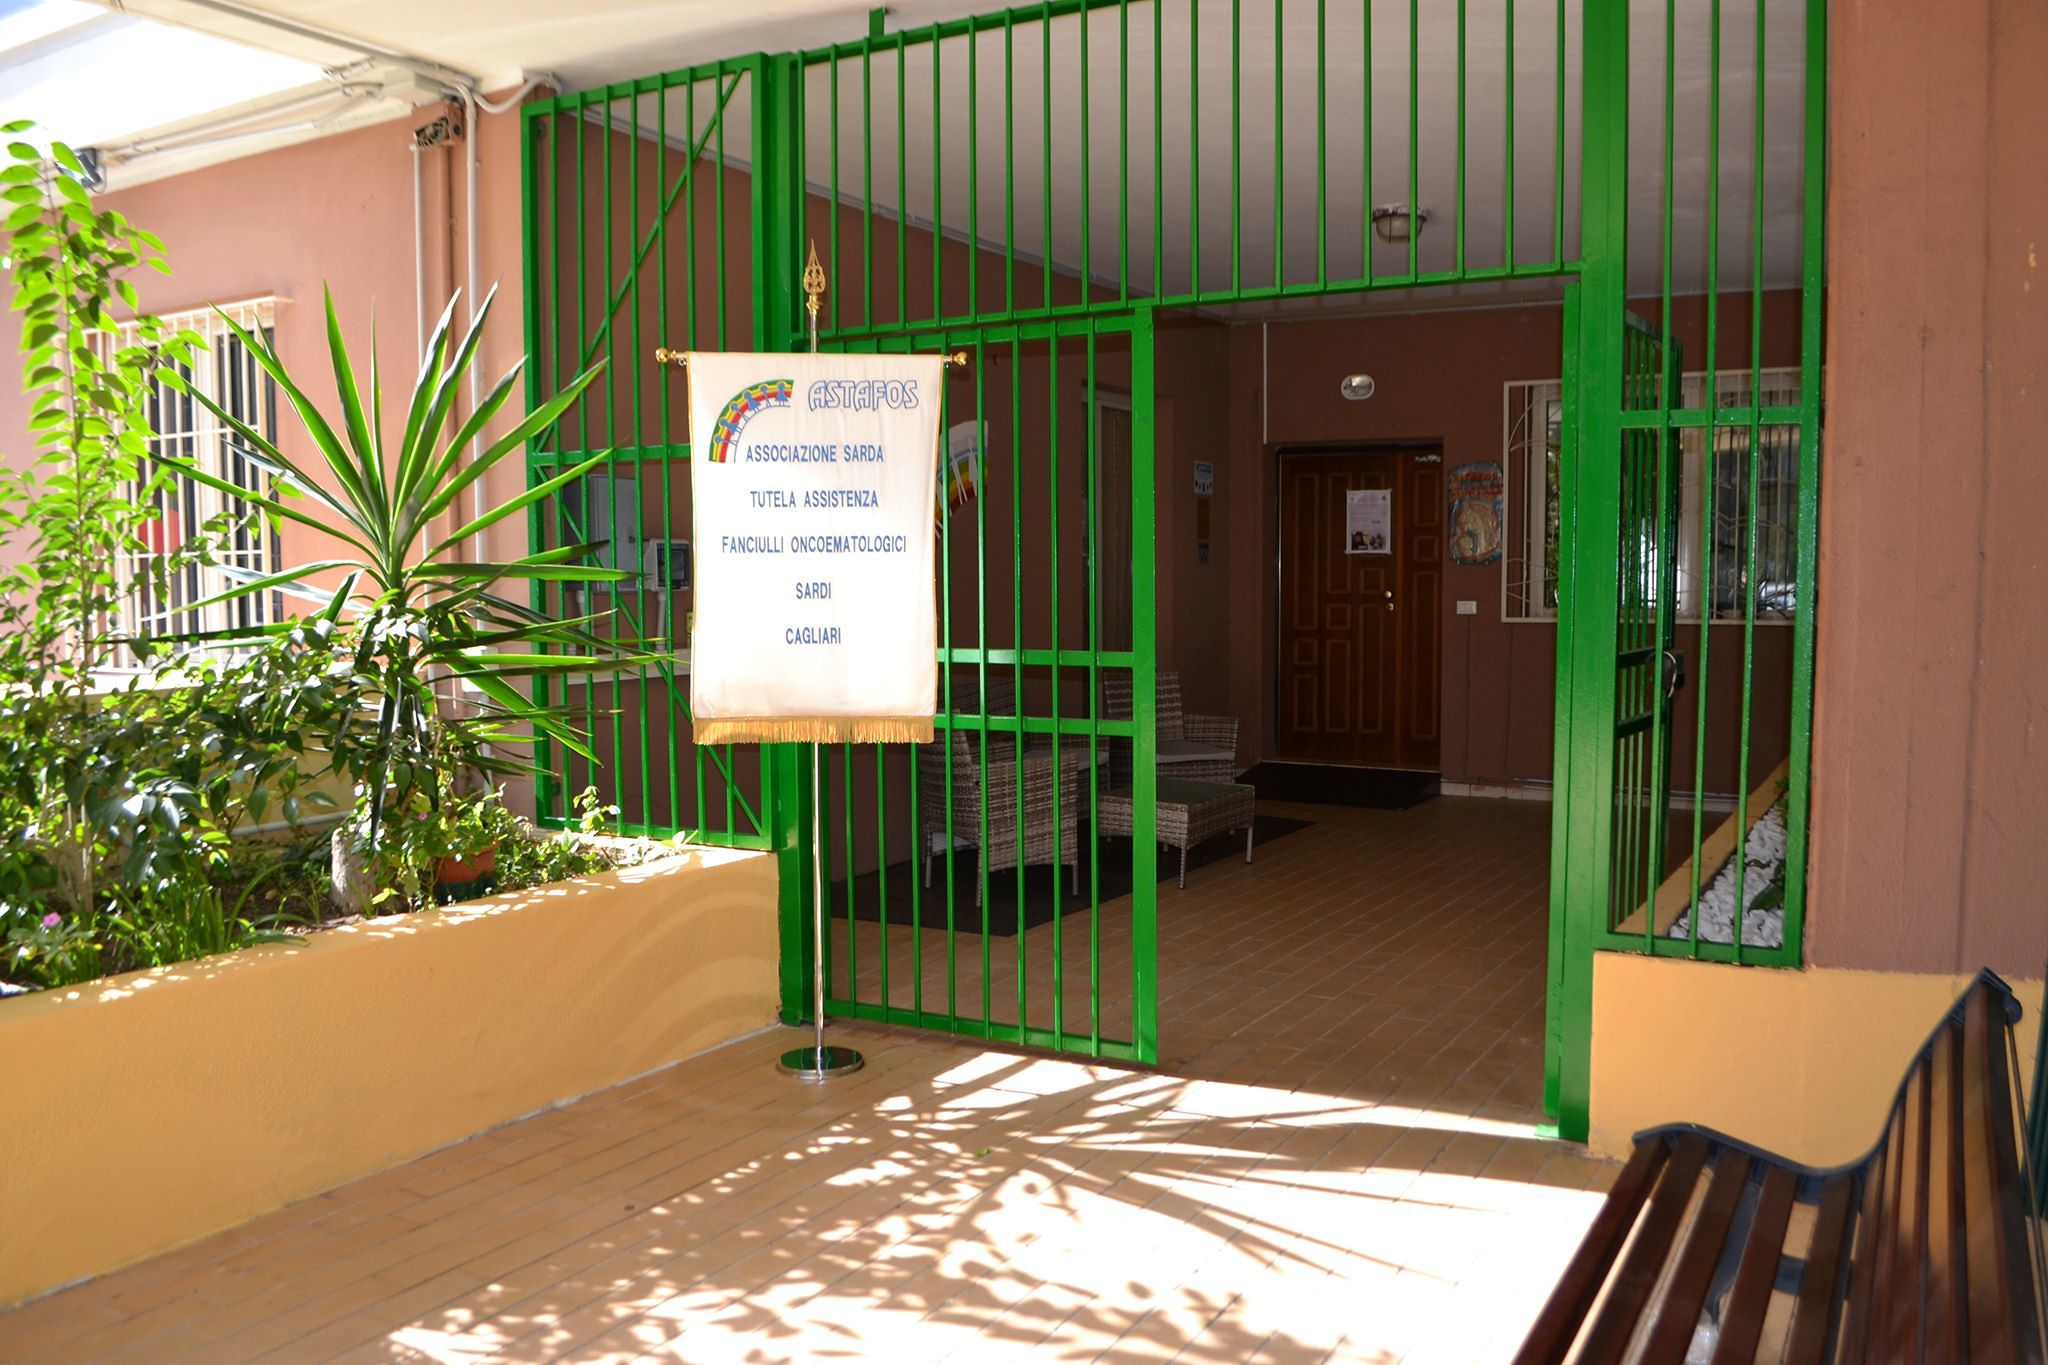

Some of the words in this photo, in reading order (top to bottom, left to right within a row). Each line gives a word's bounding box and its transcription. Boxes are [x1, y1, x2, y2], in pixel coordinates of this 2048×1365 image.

[808, 380, 919, 412] ASTAFOS
[746, 444, 837, 463] ASSOCIAZIONE
[844, 444, 884, 463] SARDA
[750, 490, 797, 508] TUTELA
[803, 490, 879, 508] ASSISTENZA
[722, 536, 784, 554] FANCIULLI
[791, 535, 907, 554] ONCOEMATOLOGICI
[795, 582, 832, 600] SARDI
[785, 627, 841, 645] CAGLIARI
